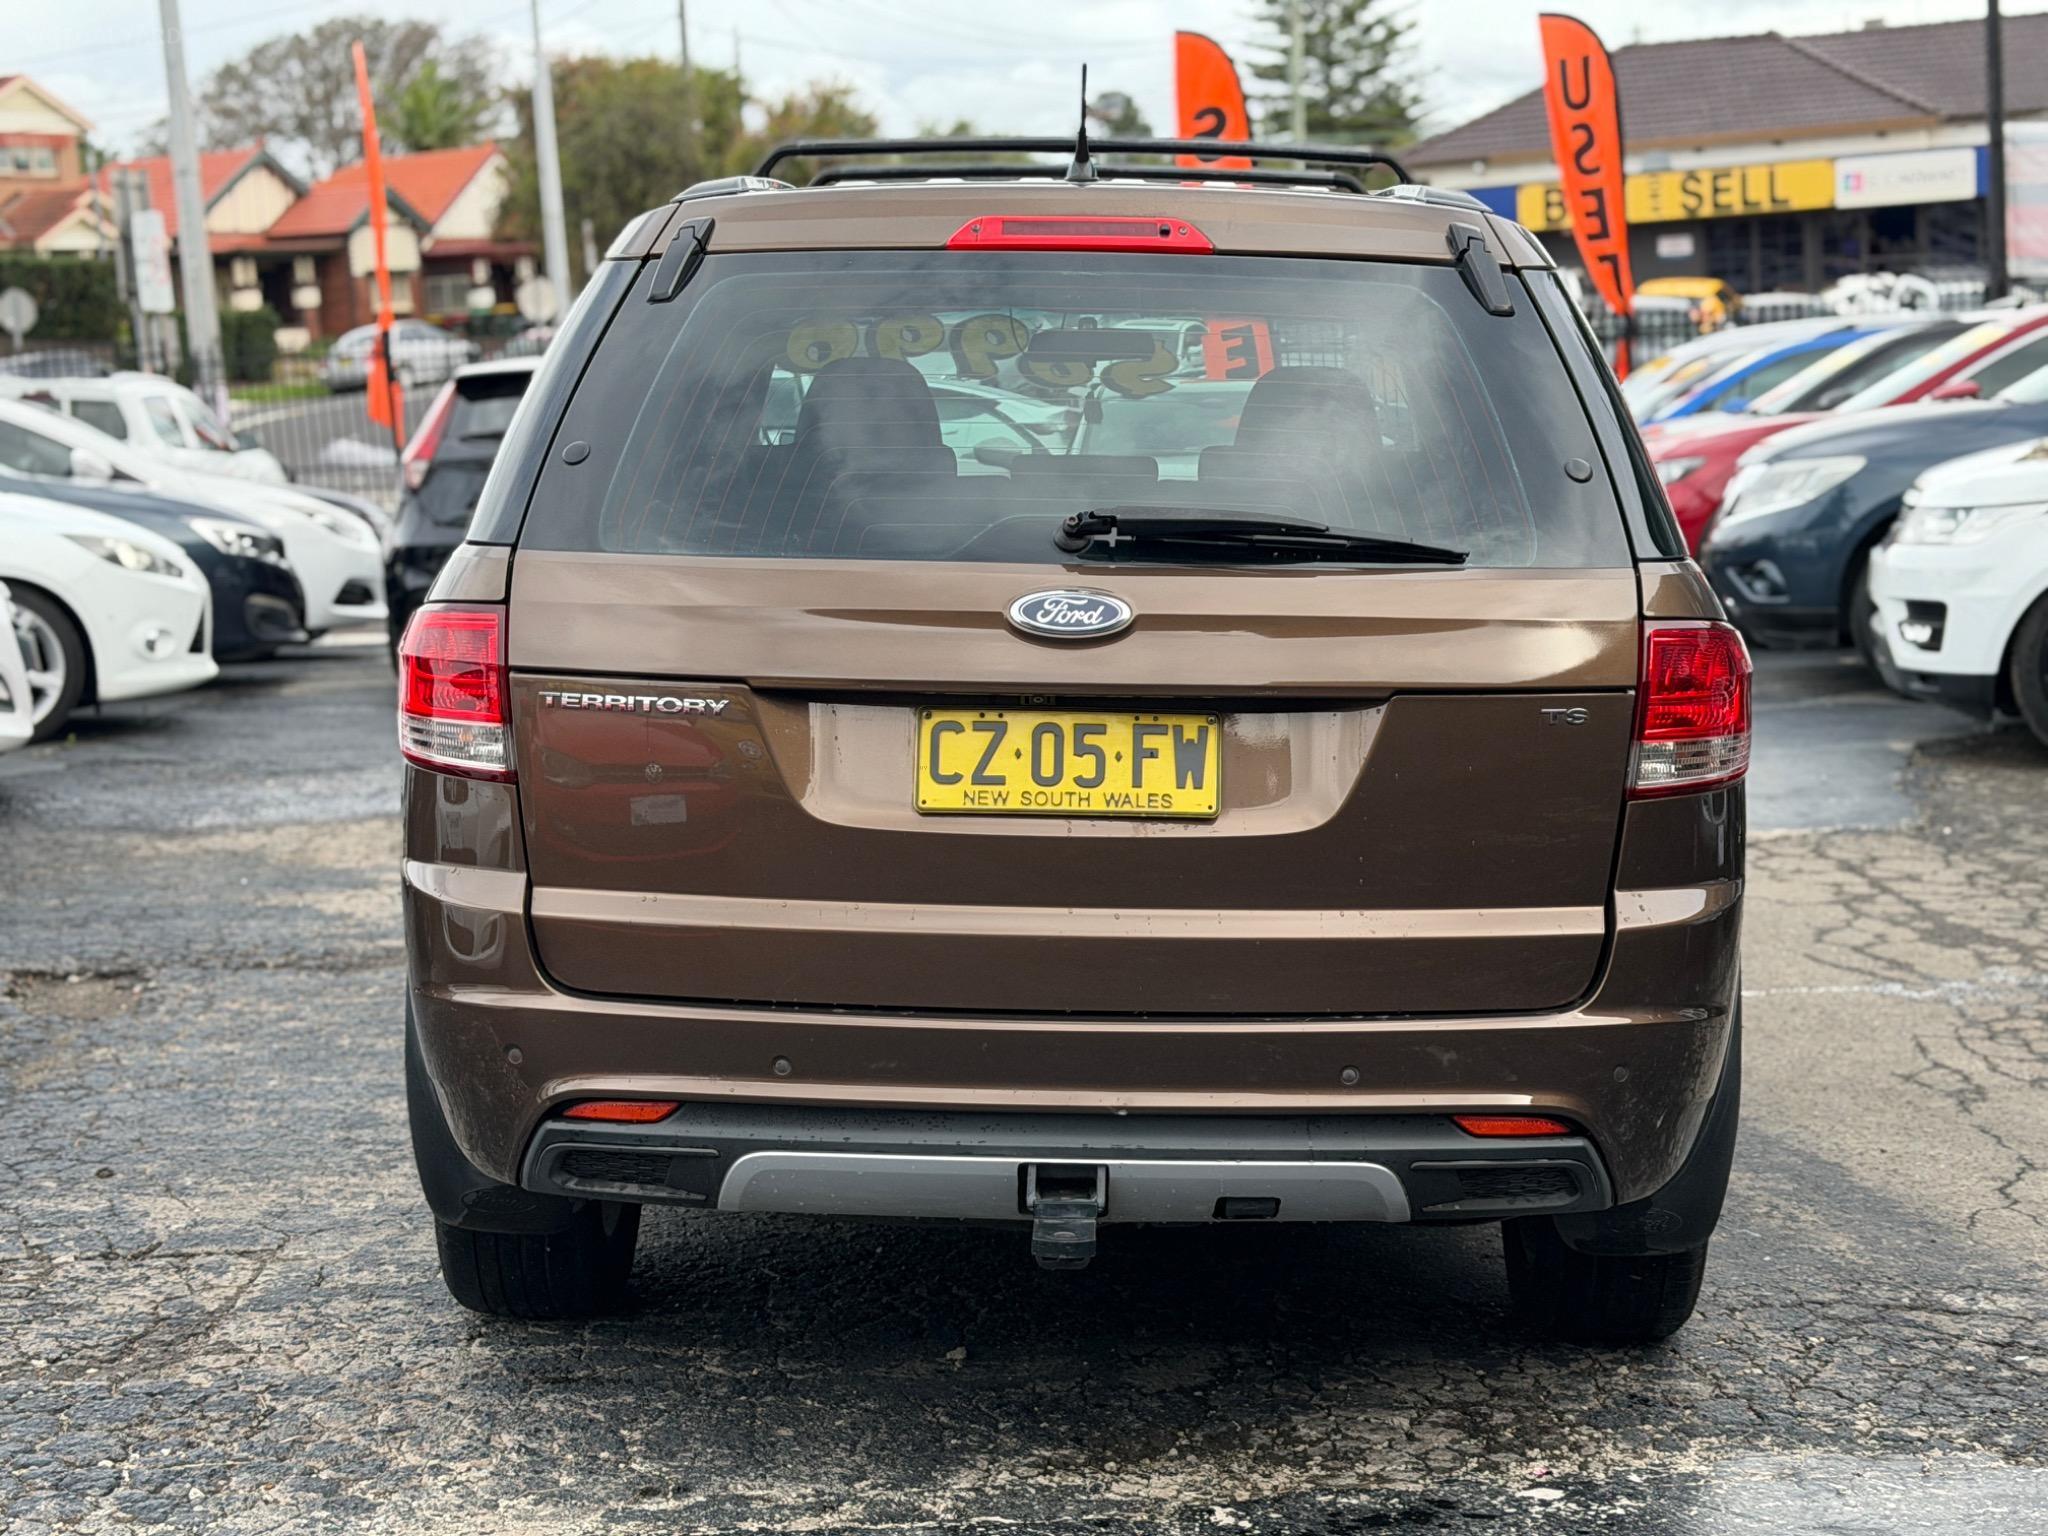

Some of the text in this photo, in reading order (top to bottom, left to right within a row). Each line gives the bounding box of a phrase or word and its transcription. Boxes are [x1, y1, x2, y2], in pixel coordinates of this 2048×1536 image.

[1681, 169, 1790, 217] SELL
[1036, 597, 1104, 625] Ford
[538, 691, 730, 716] TERRITORY
[1541, 707, 1589, 725] TS
[962, 789, 1174, 809] NEW SOUTH WALES
